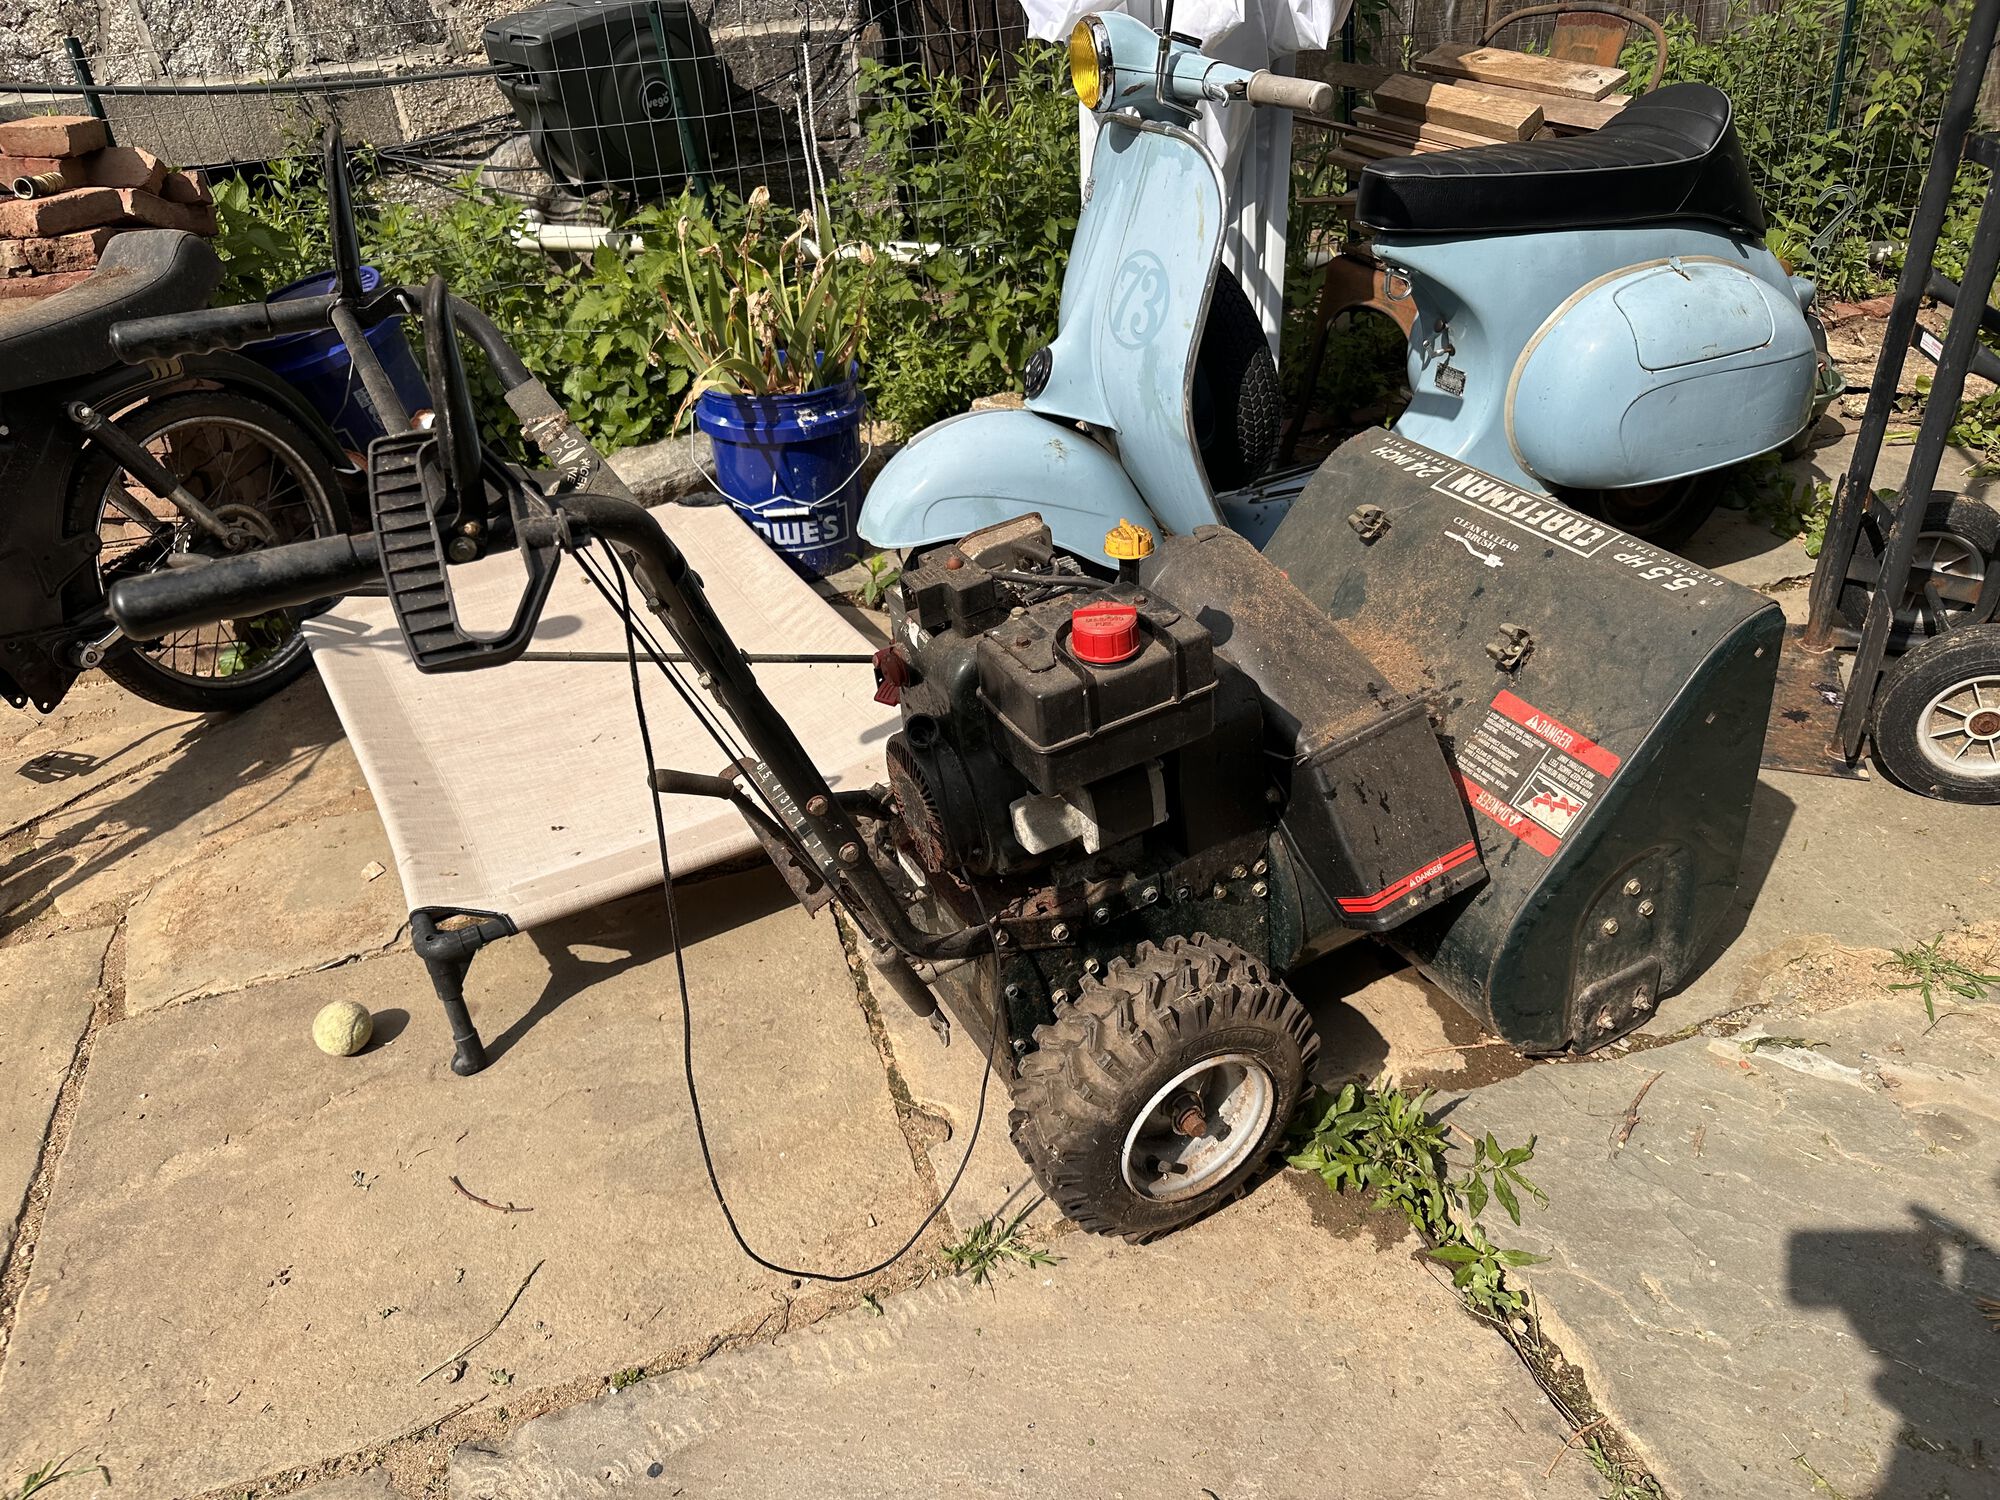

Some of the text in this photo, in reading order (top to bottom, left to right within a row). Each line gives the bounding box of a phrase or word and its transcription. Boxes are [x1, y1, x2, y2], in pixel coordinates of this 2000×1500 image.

[1112, 260, 1168, 341] 73
[1370, 446, 1445, 478] 24 INCH
[1409, 448, 1458, 471] CLEARING
[1447, 473, 1606, 547] CRAFTSMAN
[1453, 516, 1482, 535] CLEAN
[1464, 531, 1497, 550] BRUSH
[1613, 553, 1698, 591] 5.5 HP
[1619, 539, 1724, 587] ELECTRIC START
[1536, 720, 1574, 749] DANGER
[781, 795, 790, 804] 3
[788, 806, 798, 815] 2
[1476, 790, 1513, 821] DANGER
[1415, 863, 1444, 883] DANGER
